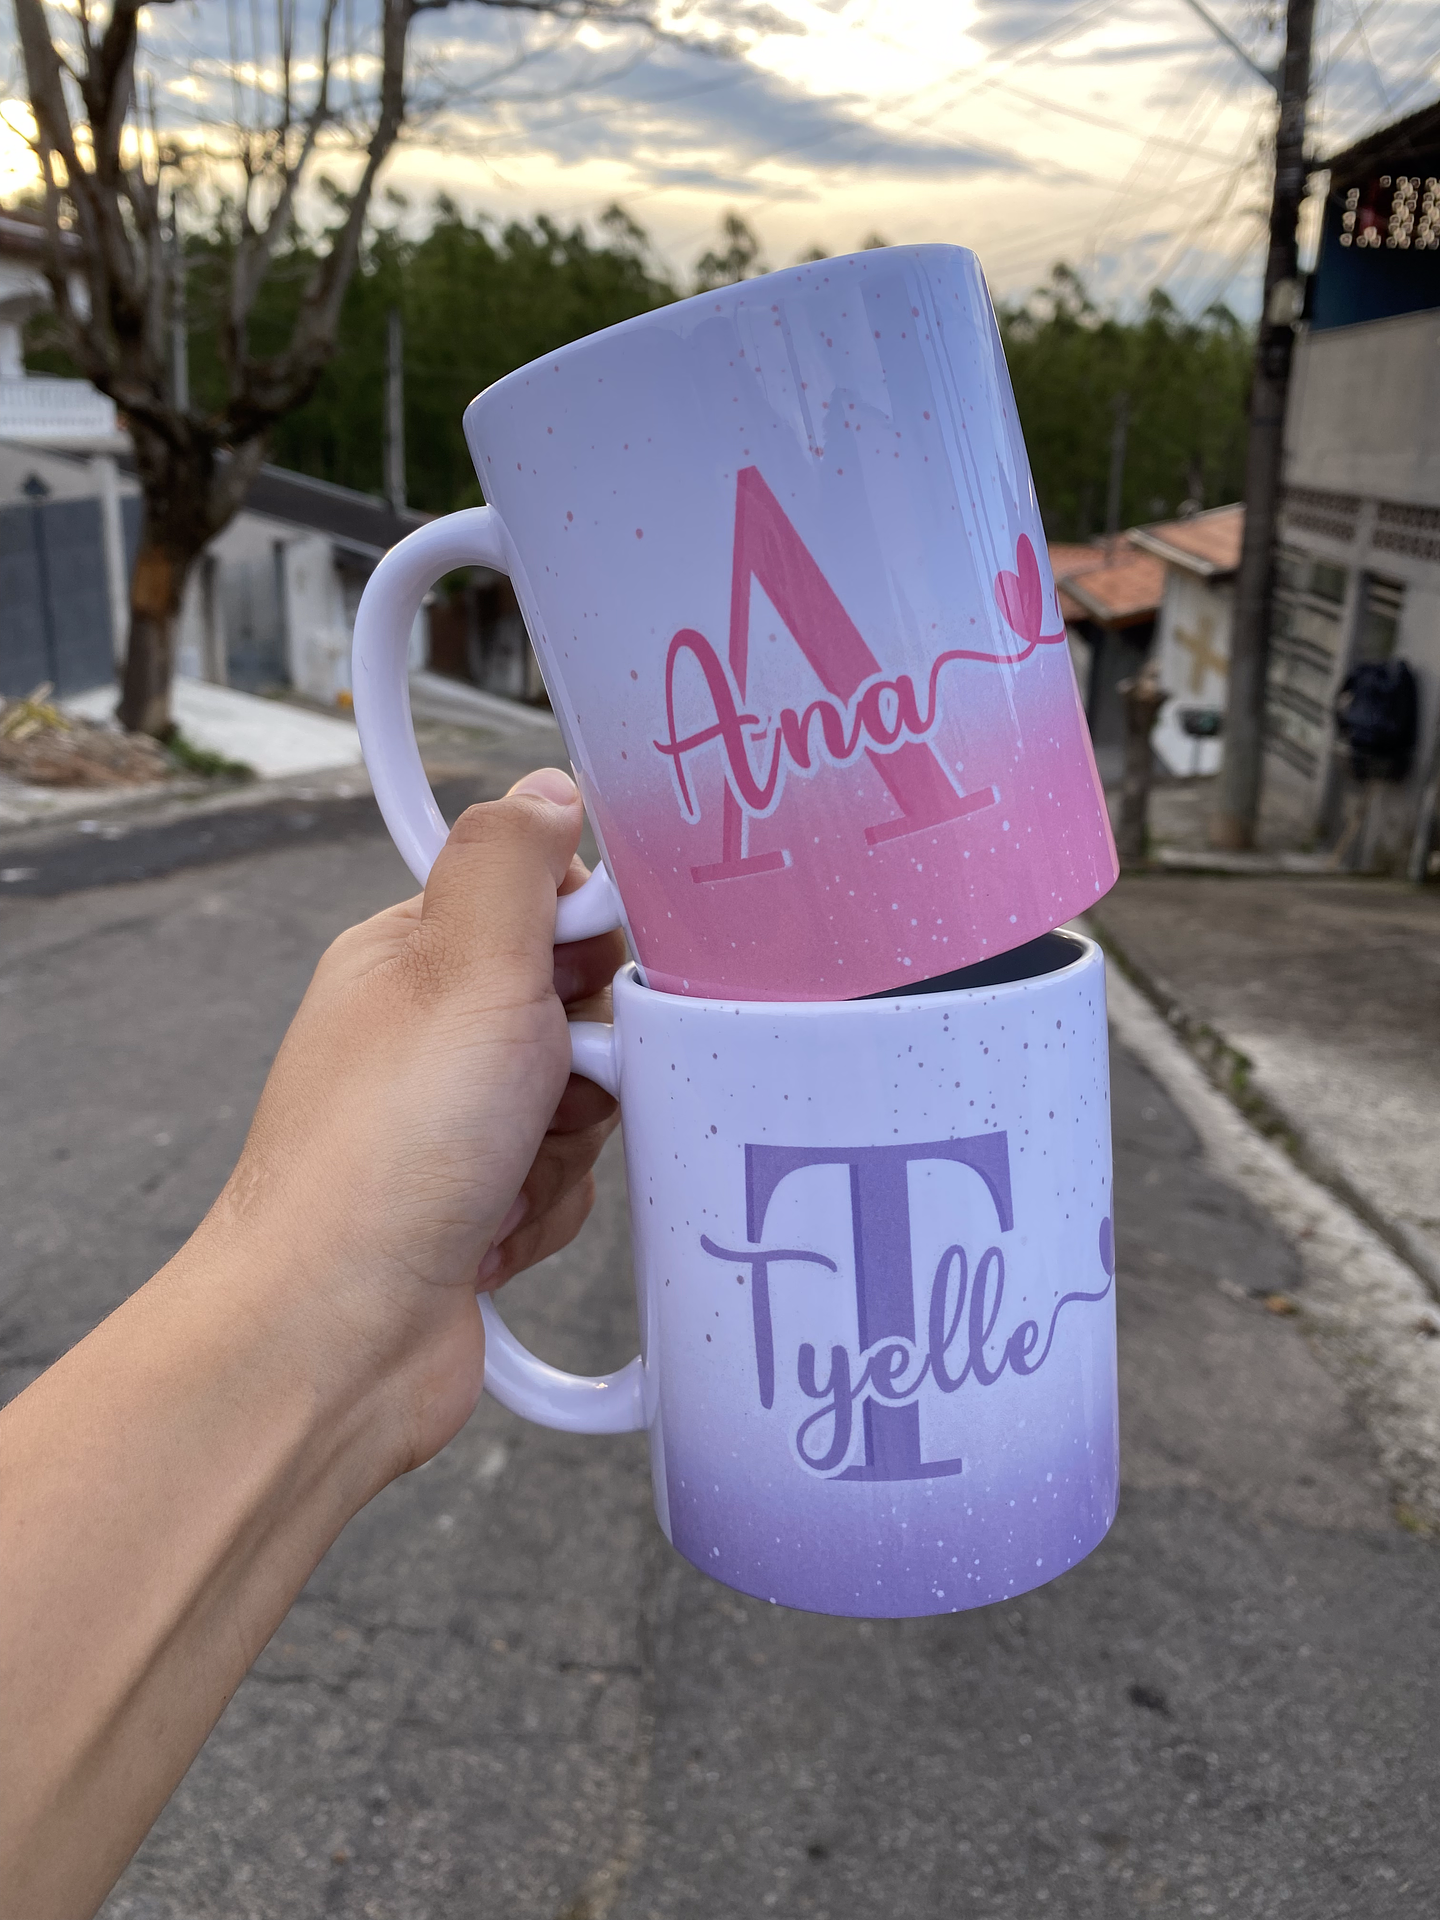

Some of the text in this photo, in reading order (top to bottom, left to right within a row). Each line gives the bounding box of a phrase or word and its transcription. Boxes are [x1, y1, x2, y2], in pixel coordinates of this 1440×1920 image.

[653, 627, 942, 816] Ana
[691, 465, 996, 884] A
[700, 1234, 1054, 1471] Tyelle
[744, 1130, 1014, 1482] T
